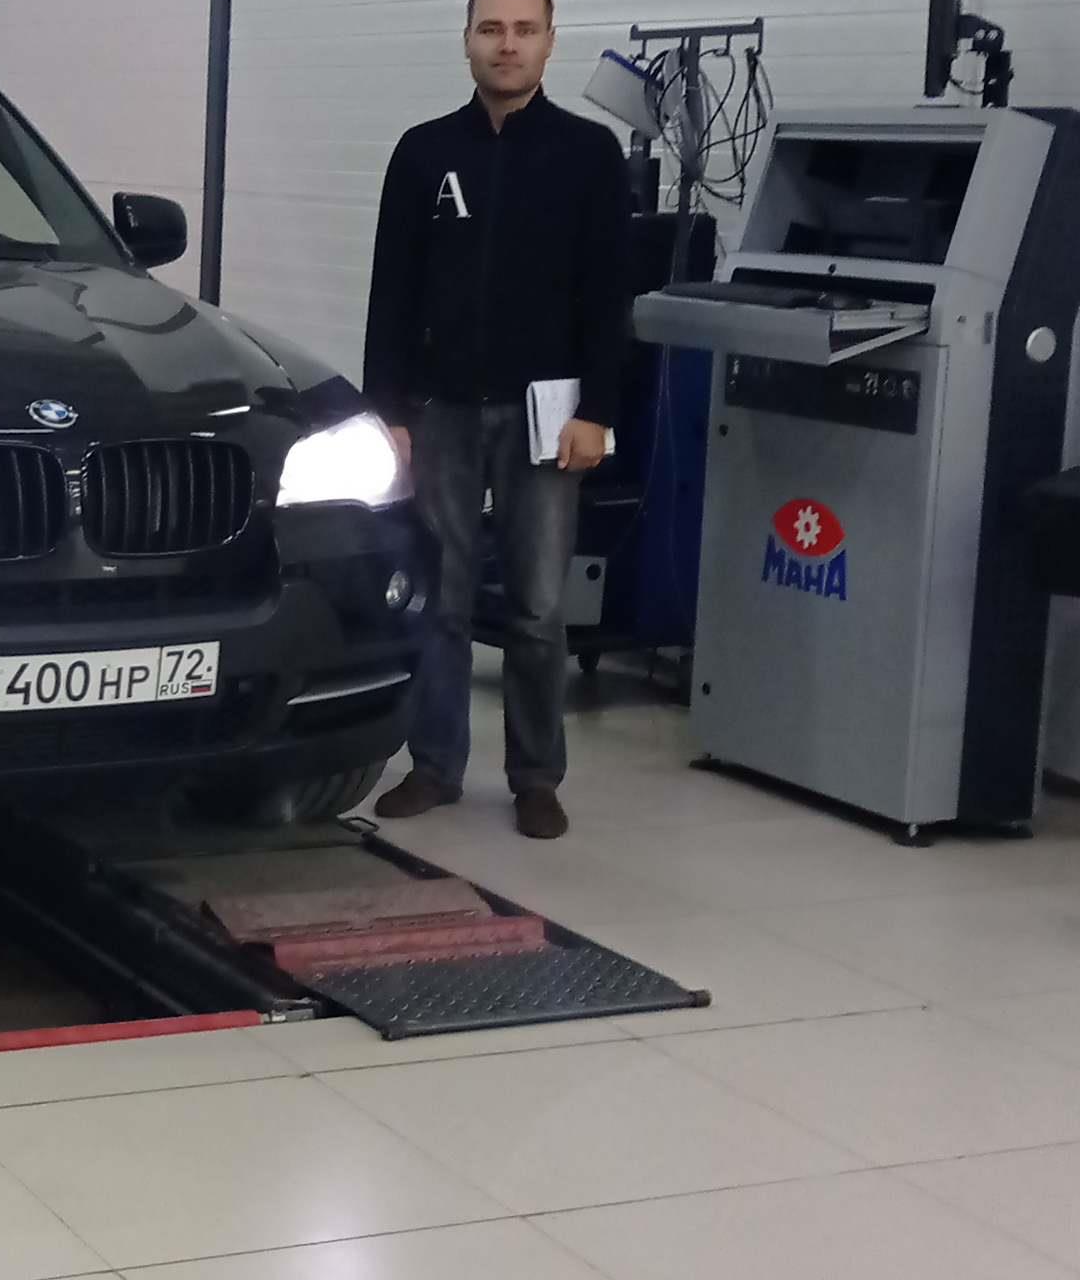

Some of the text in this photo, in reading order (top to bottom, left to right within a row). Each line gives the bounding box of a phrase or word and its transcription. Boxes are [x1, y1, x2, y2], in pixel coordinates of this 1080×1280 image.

[761, 533, 847, 600] MAHA
[166, 648, 205, 683] 72
[159, 683, 190, 696] RUS
